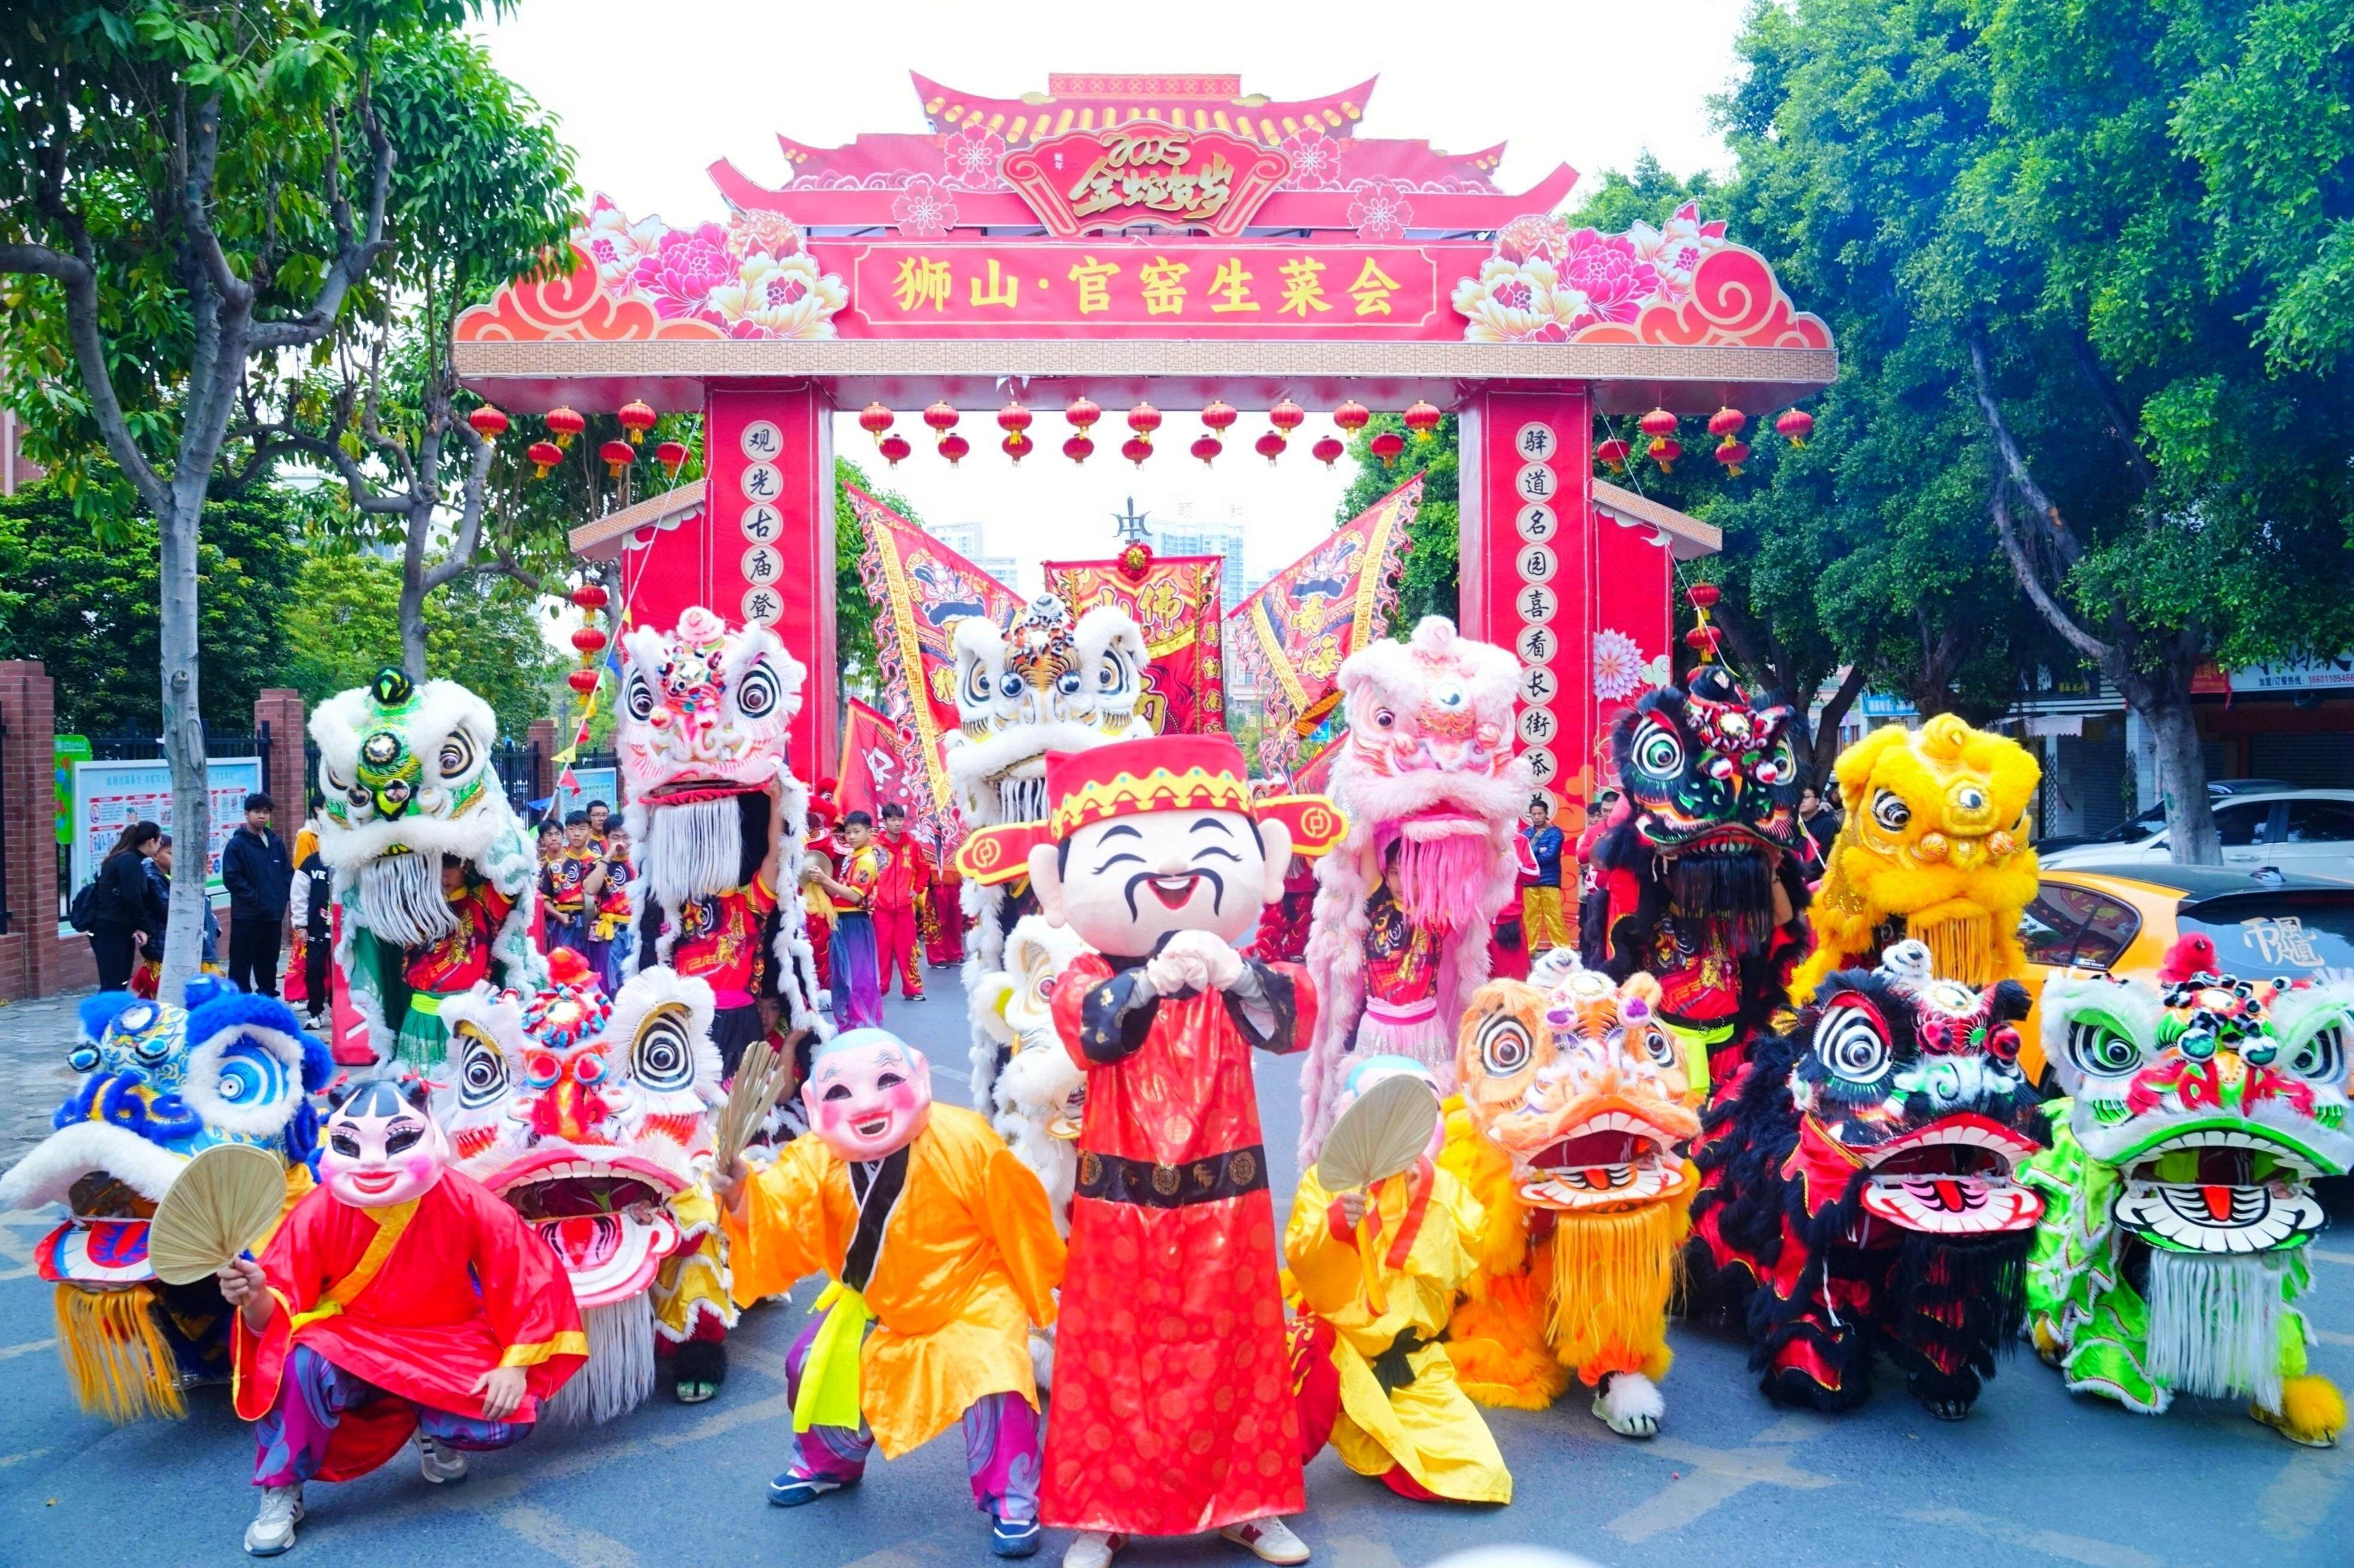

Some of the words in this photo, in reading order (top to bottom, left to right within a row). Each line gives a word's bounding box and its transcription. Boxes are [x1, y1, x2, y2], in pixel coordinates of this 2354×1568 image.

[1102, 131, 1191, 167] 2025
[1068, 152, 1234, 221] 金蛇贺岁
[891, 255, 1402, 317] 狮山·官窑生菜会
[747, 429, 777, 619] 观光古庙登
